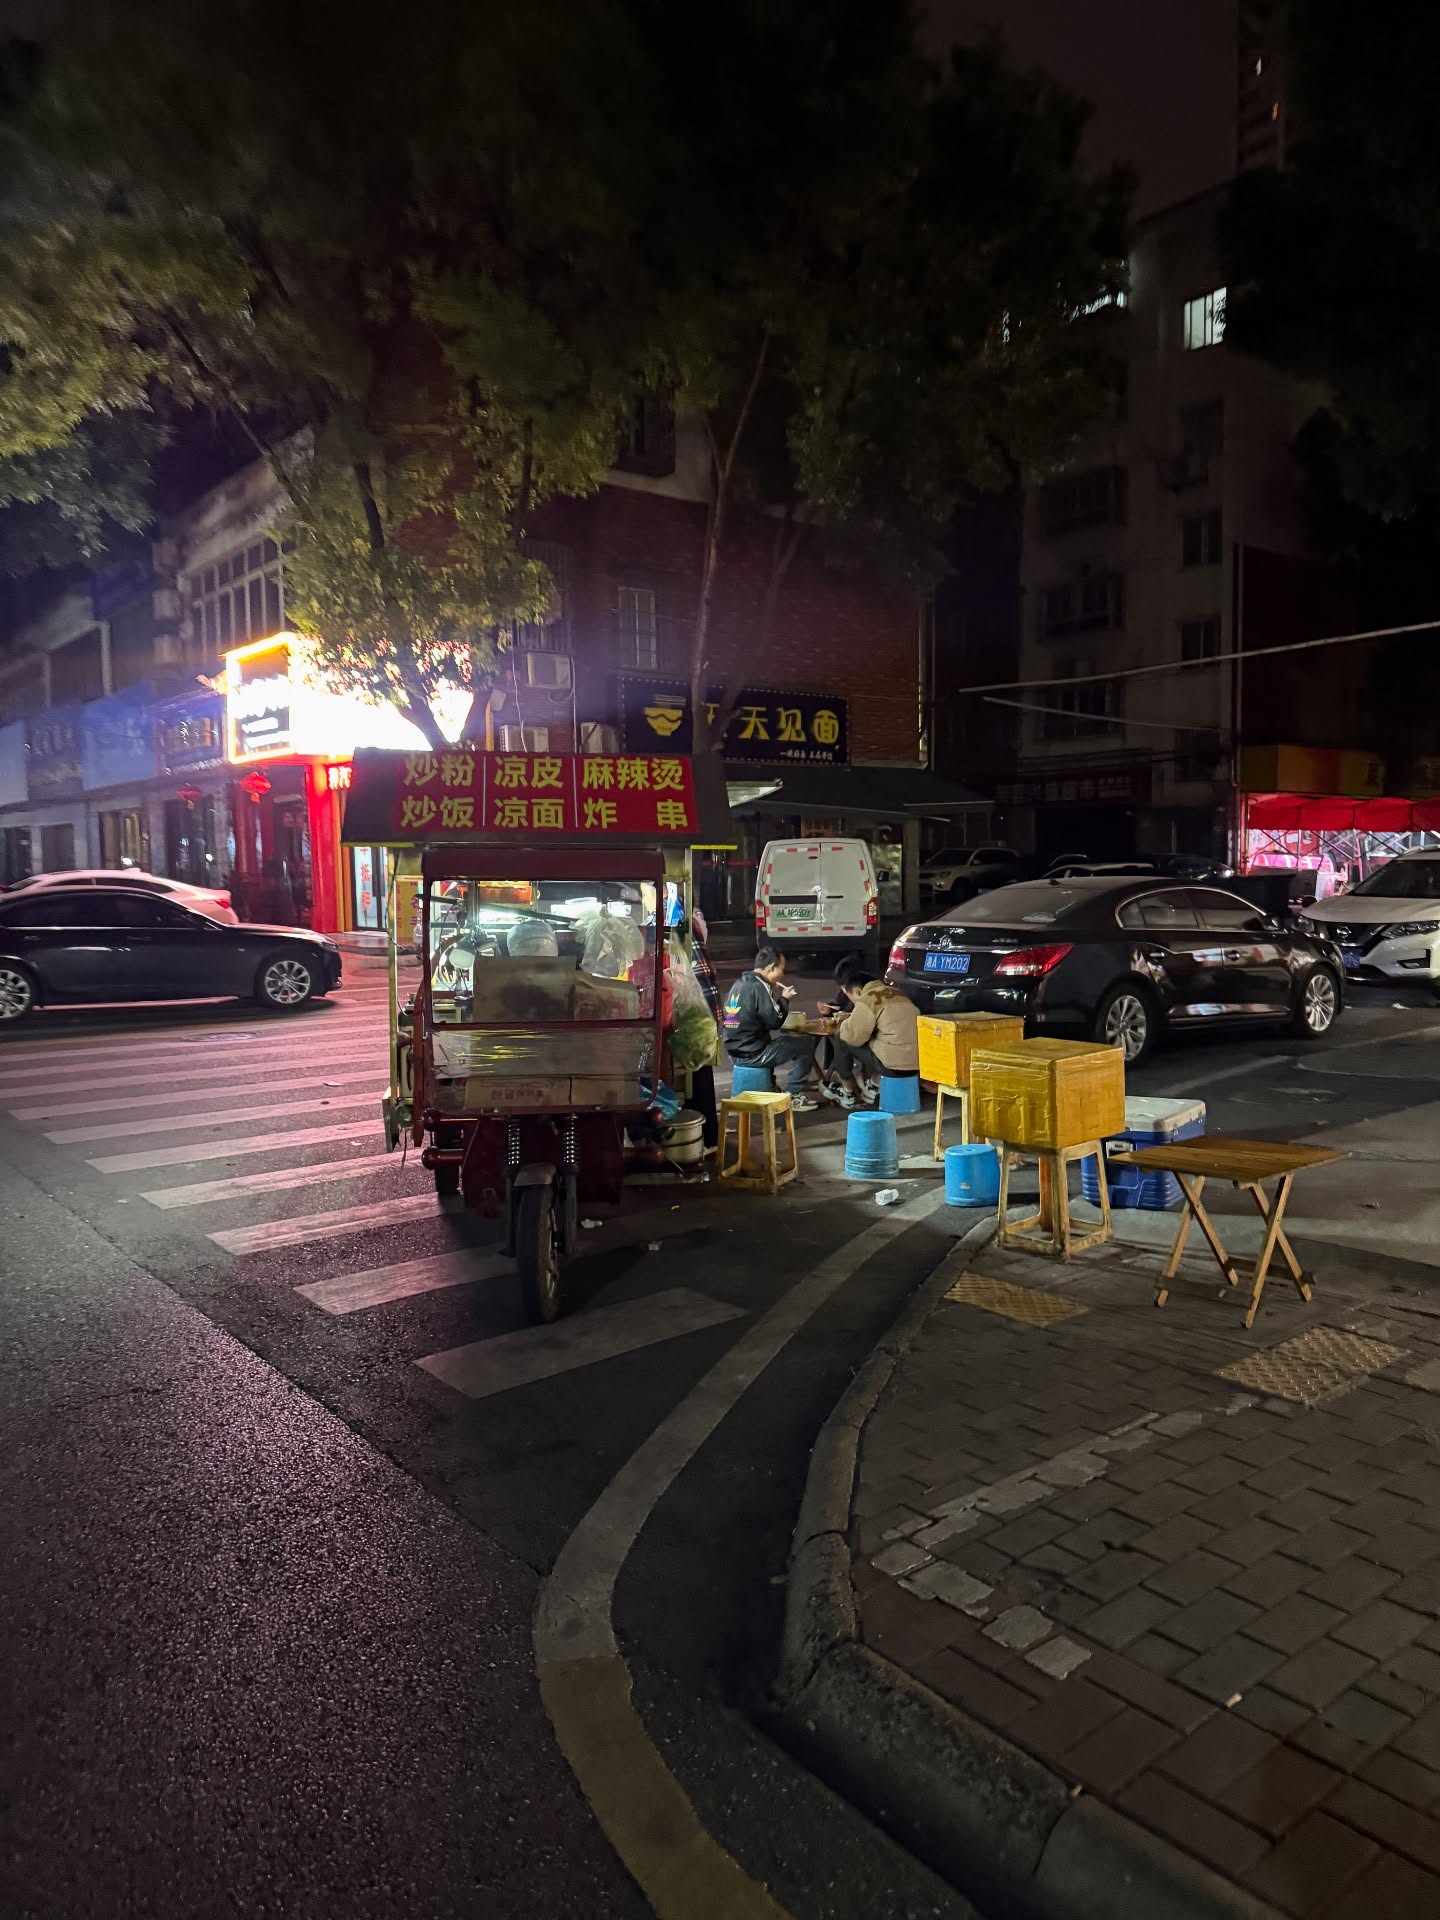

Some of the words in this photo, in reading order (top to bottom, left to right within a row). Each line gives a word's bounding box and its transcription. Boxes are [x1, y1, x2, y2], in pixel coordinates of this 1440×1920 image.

[403, 753, 475, 787] 炒粉
[494, 756, 564, 789] 凉皮
[582, 757, 685, 791] 麻辣烫
[400, 795, 475, 829] 炒饭
[493, 797, 564, 829] 凉面
